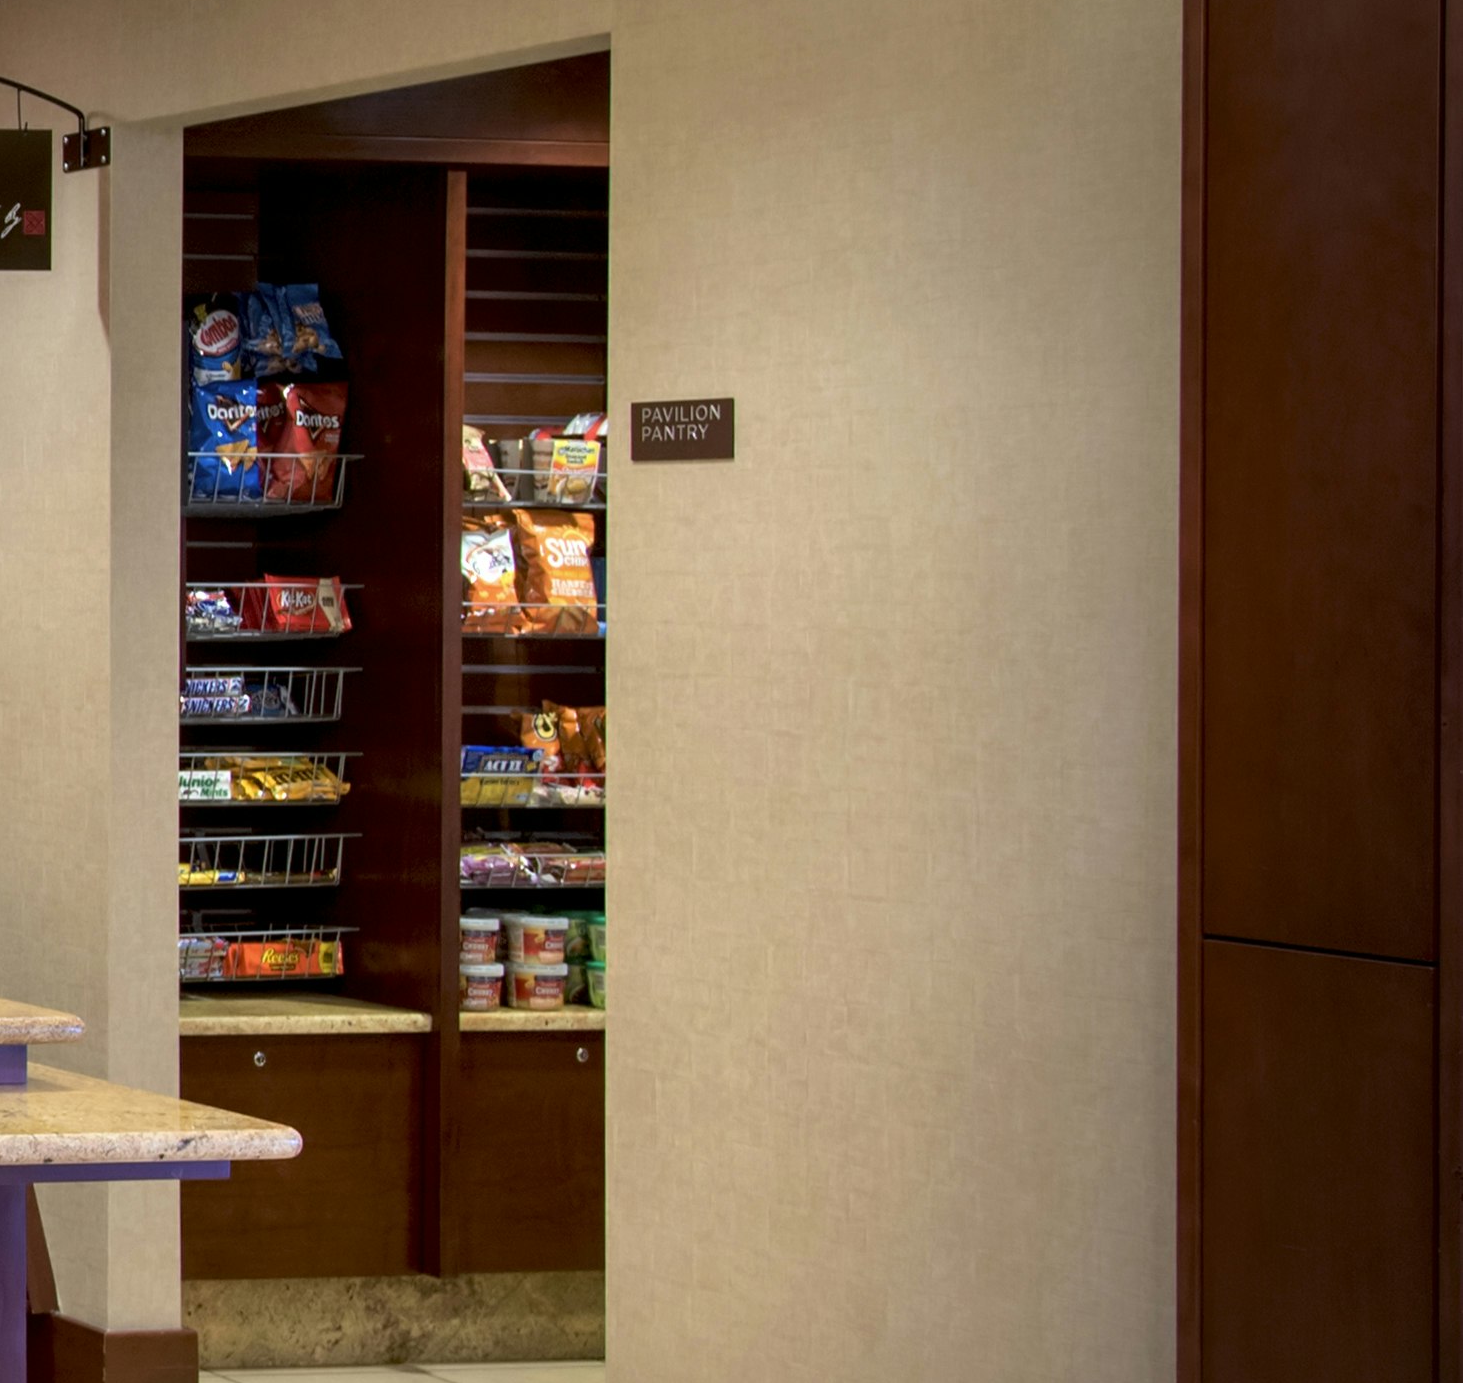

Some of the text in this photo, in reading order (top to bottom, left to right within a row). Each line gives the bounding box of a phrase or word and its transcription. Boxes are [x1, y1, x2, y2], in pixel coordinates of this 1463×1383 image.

[207, 402, 256, 420] Dorito
[296, 410, 339, 428] Doritos
[642, 404, 721, 423] PAVILION
[642, 424, 709, 442] PANTRY
